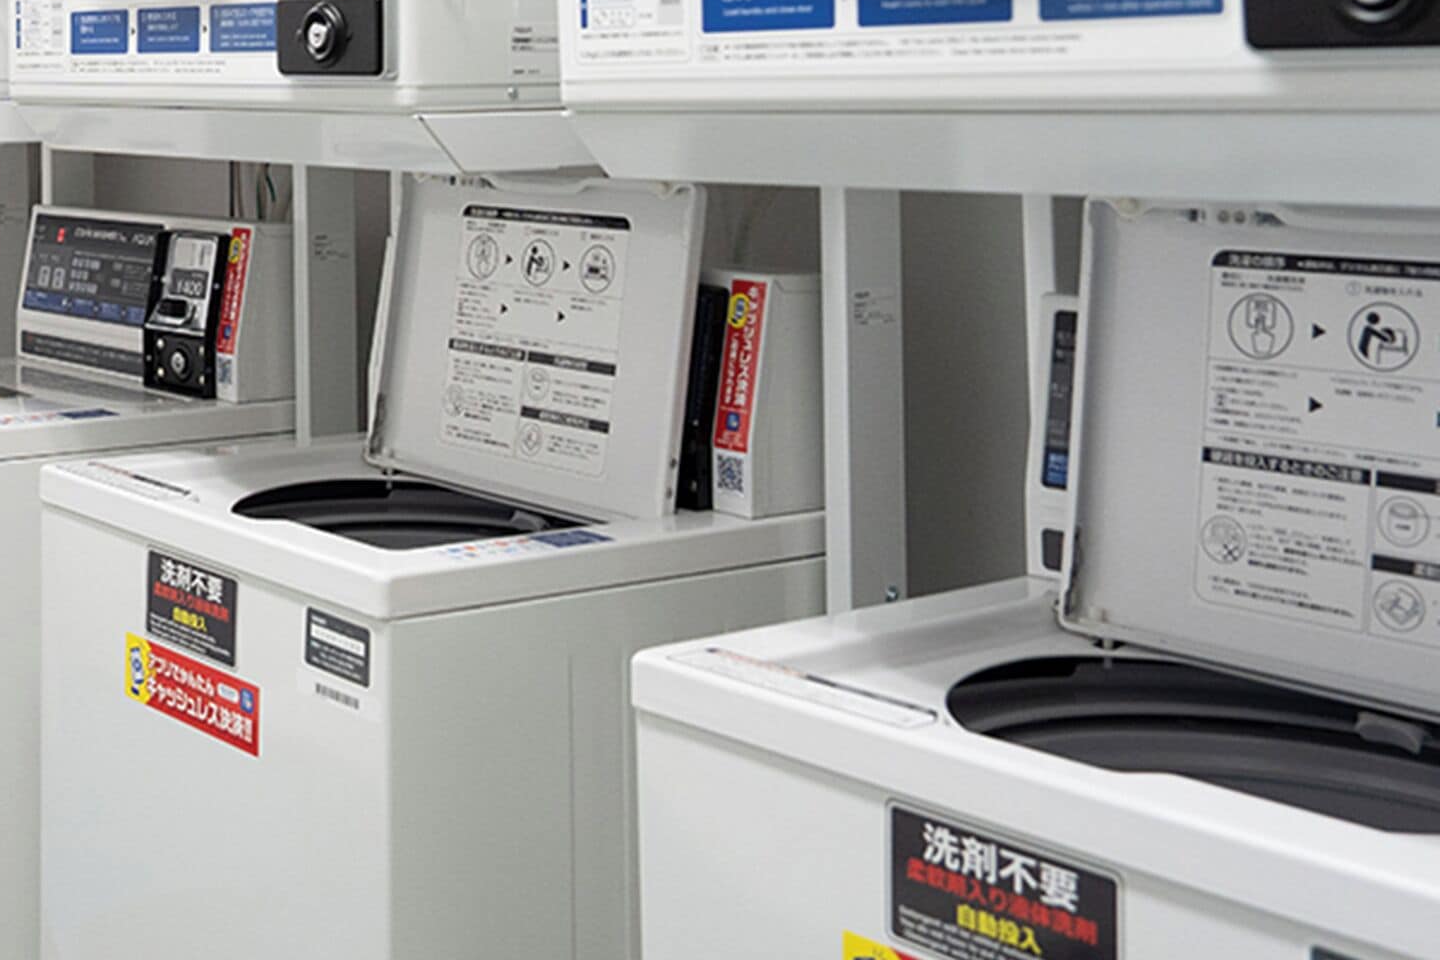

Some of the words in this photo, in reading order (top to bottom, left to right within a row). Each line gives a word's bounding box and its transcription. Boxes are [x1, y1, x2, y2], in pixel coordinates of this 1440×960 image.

[160, 557, 224, 605] 洗剤不要
[906, 856, 1099, 947] 柔軟剤入り液体洗剤
[921, 821, 1081, 913] 洗剤不要
[955, 903, 1043, 957] 自動投入
